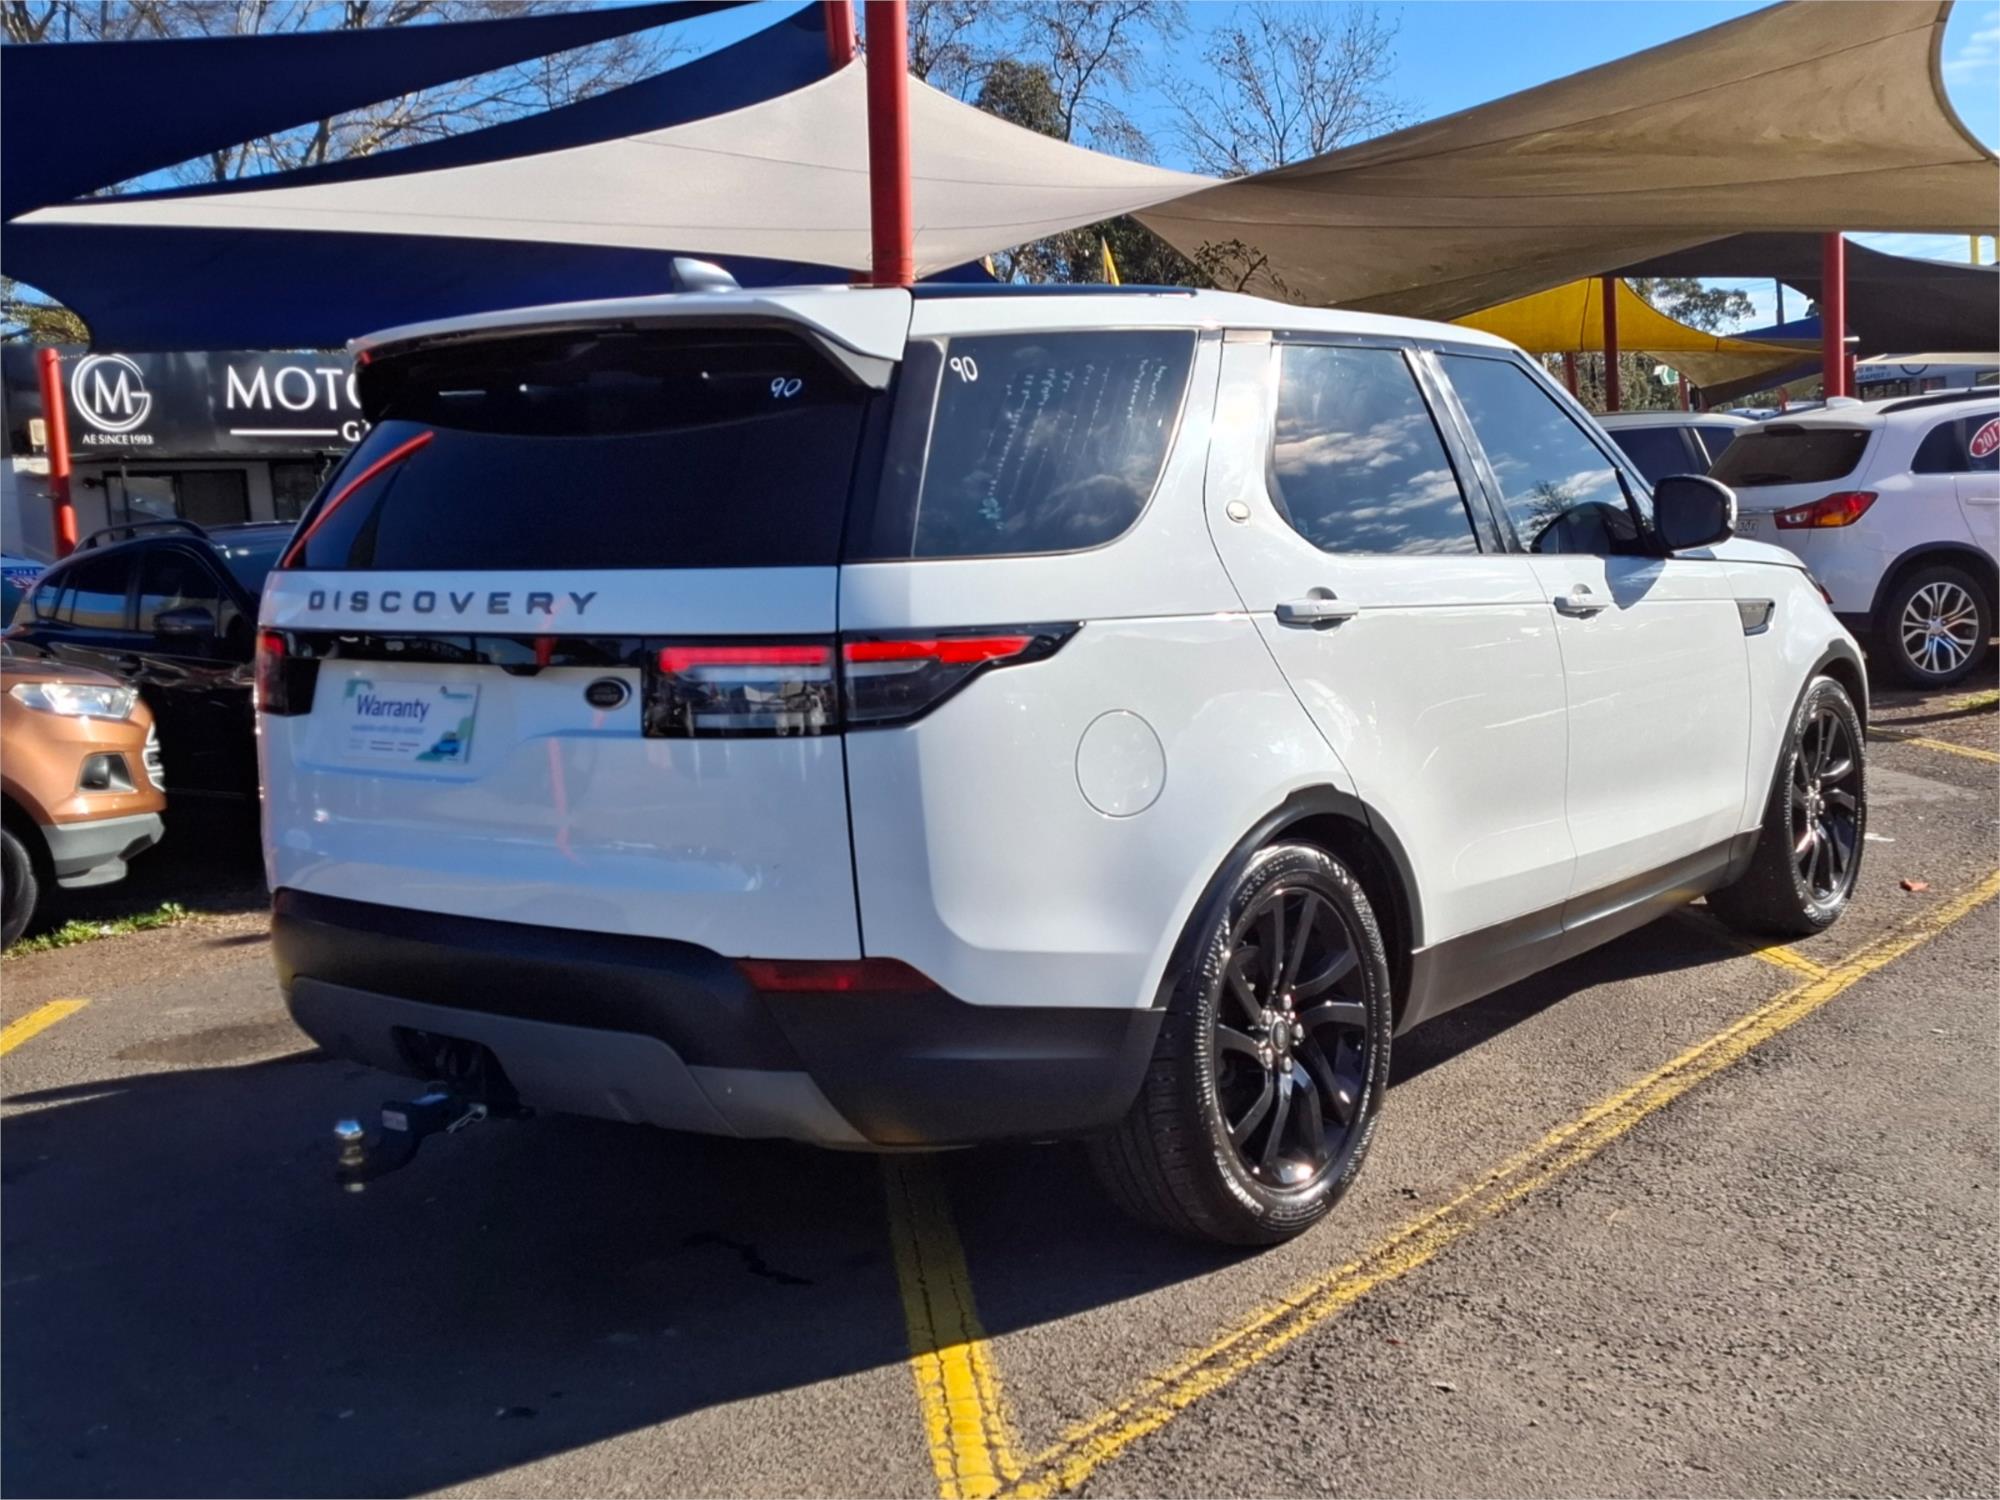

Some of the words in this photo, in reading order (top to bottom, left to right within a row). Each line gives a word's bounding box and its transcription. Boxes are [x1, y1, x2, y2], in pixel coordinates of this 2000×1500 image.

[950, 356, 978, 384] 90
[770, 376, 802, 397] 90
[82, 434, 97, 445] AE
[98, 434, 129, 445] SINCE
[130, 434, 154, 445] 1993
[308, 590, 598, 615] DISCOVERY
[357, 694, 431, 723] Warranty
